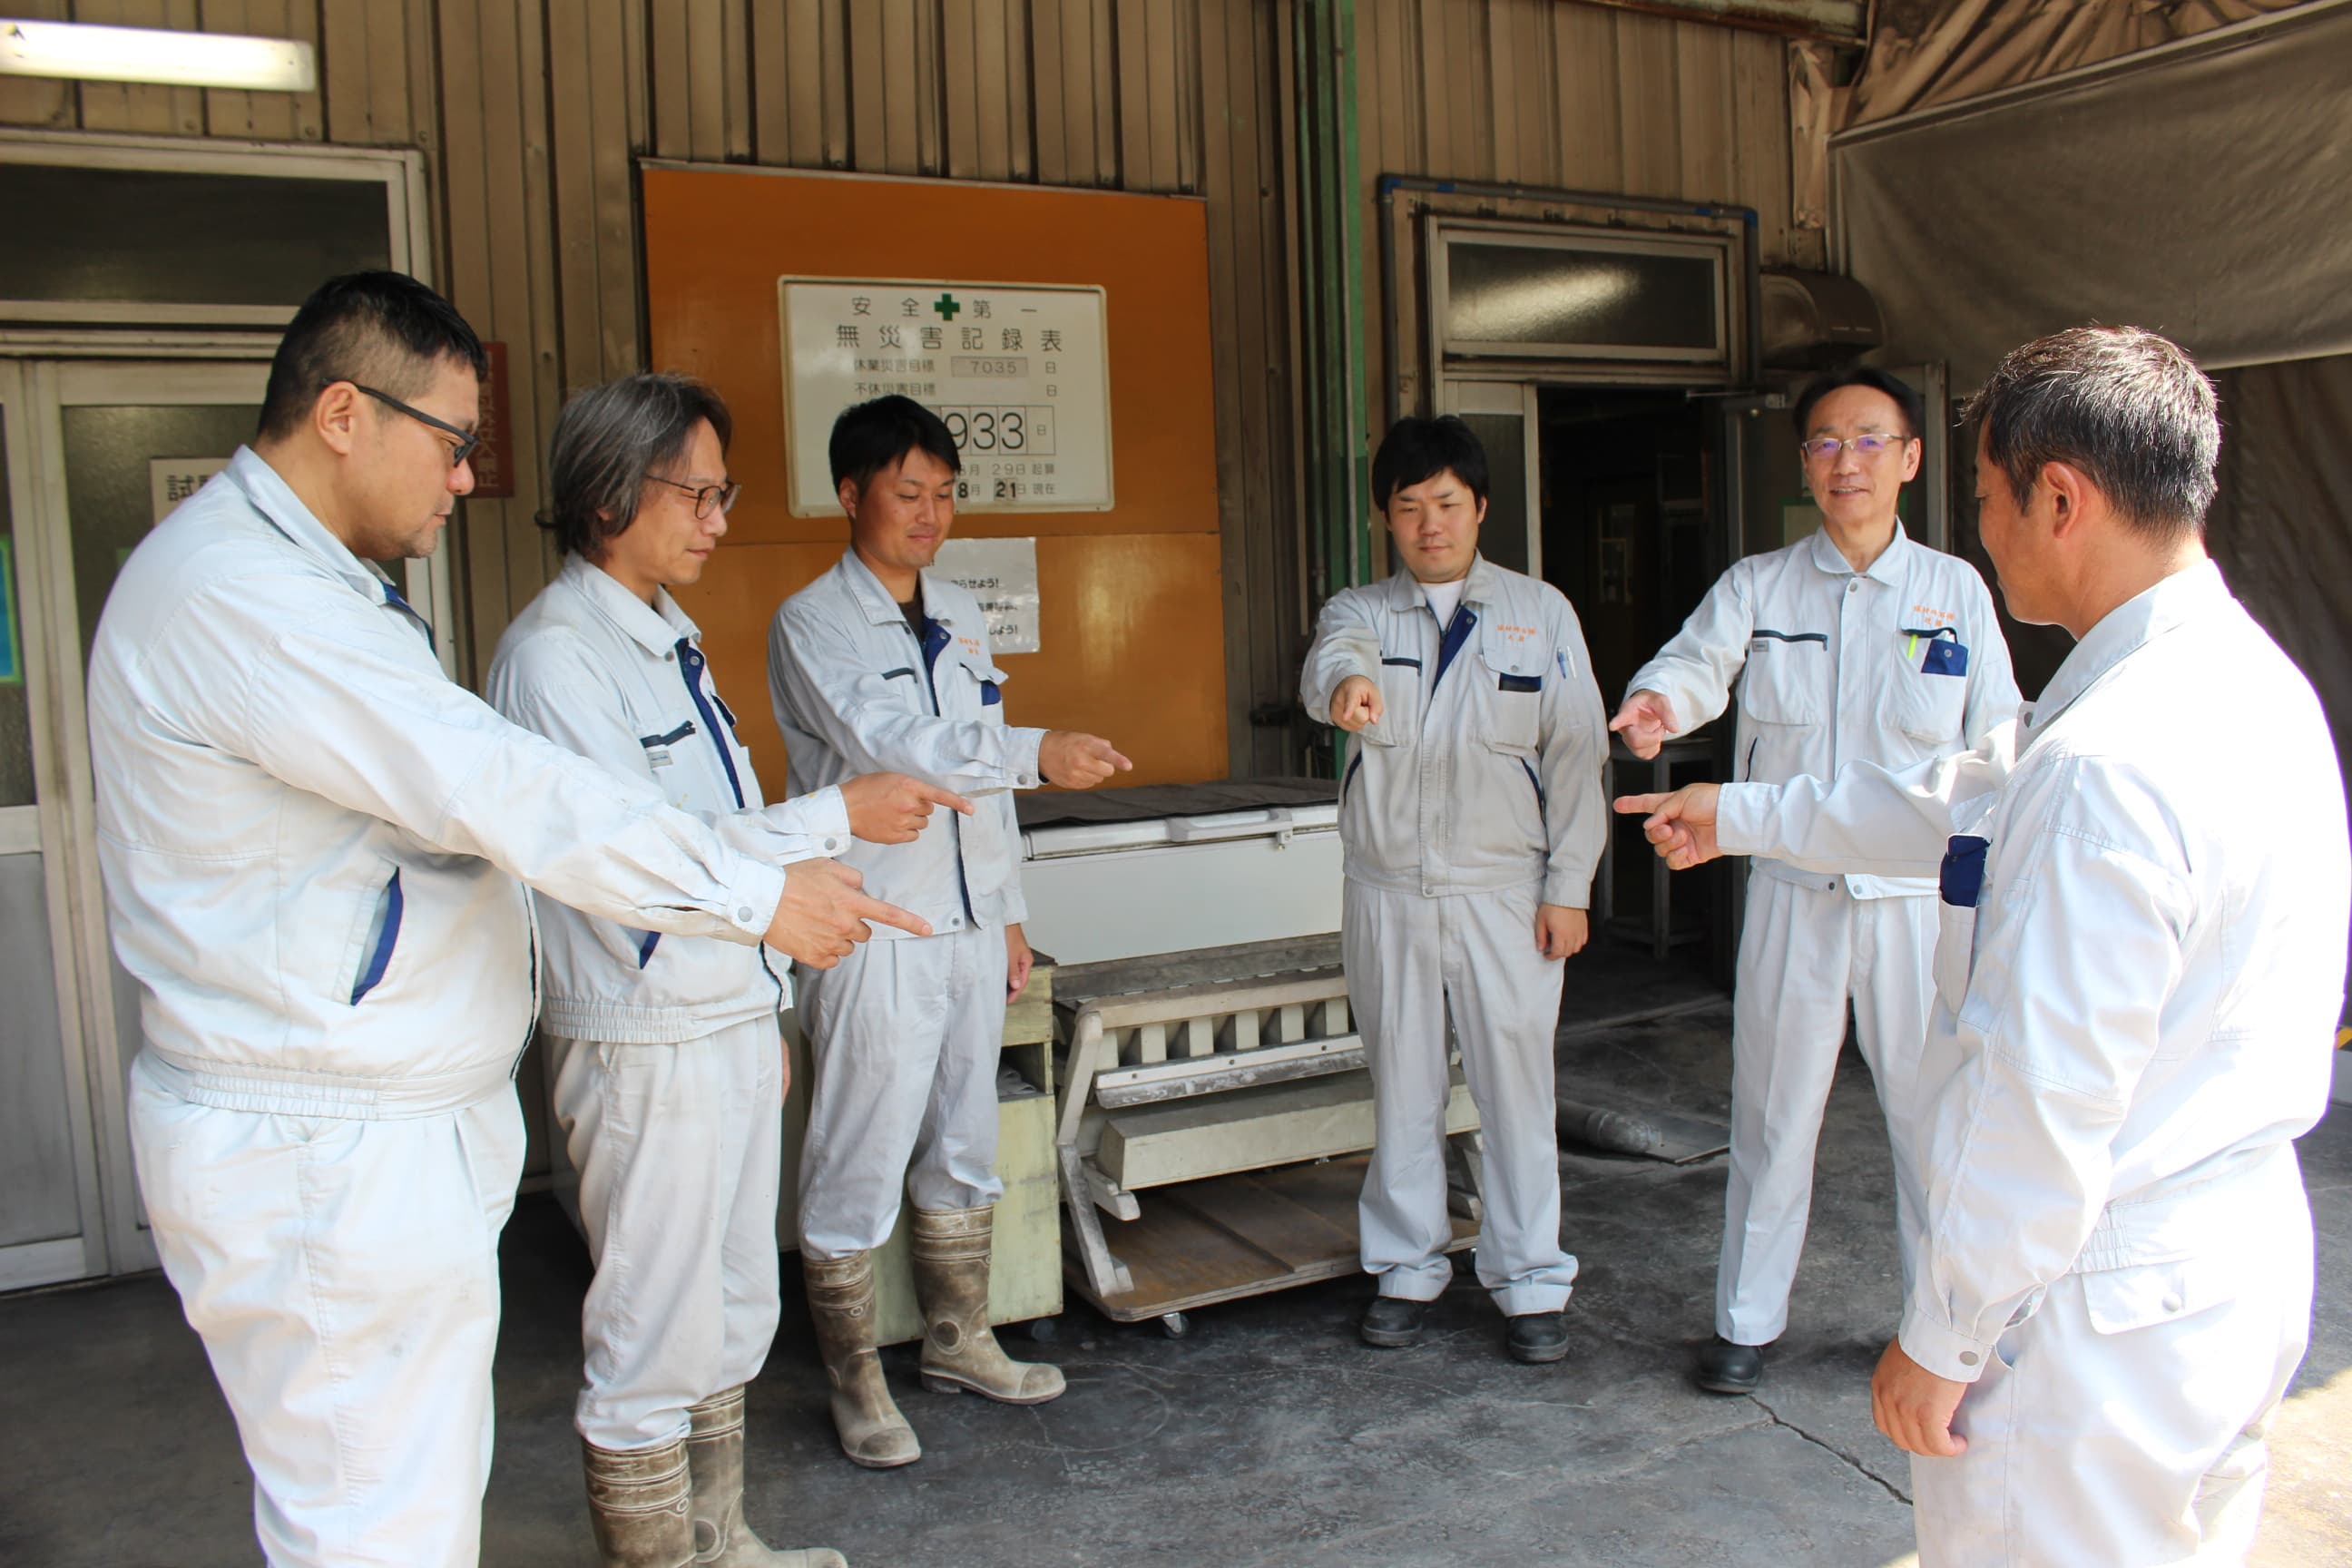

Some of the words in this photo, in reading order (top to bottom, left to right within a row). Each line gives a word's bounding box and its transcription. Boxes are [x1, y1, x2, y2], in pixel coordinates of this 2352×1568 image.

[836, 324, 1063, 352] 無災害記録表
[970, 361, 1017, 374] 7035
[1045, 361, 1056, 374] 日
[1046, 384, 1057, 397] 日
